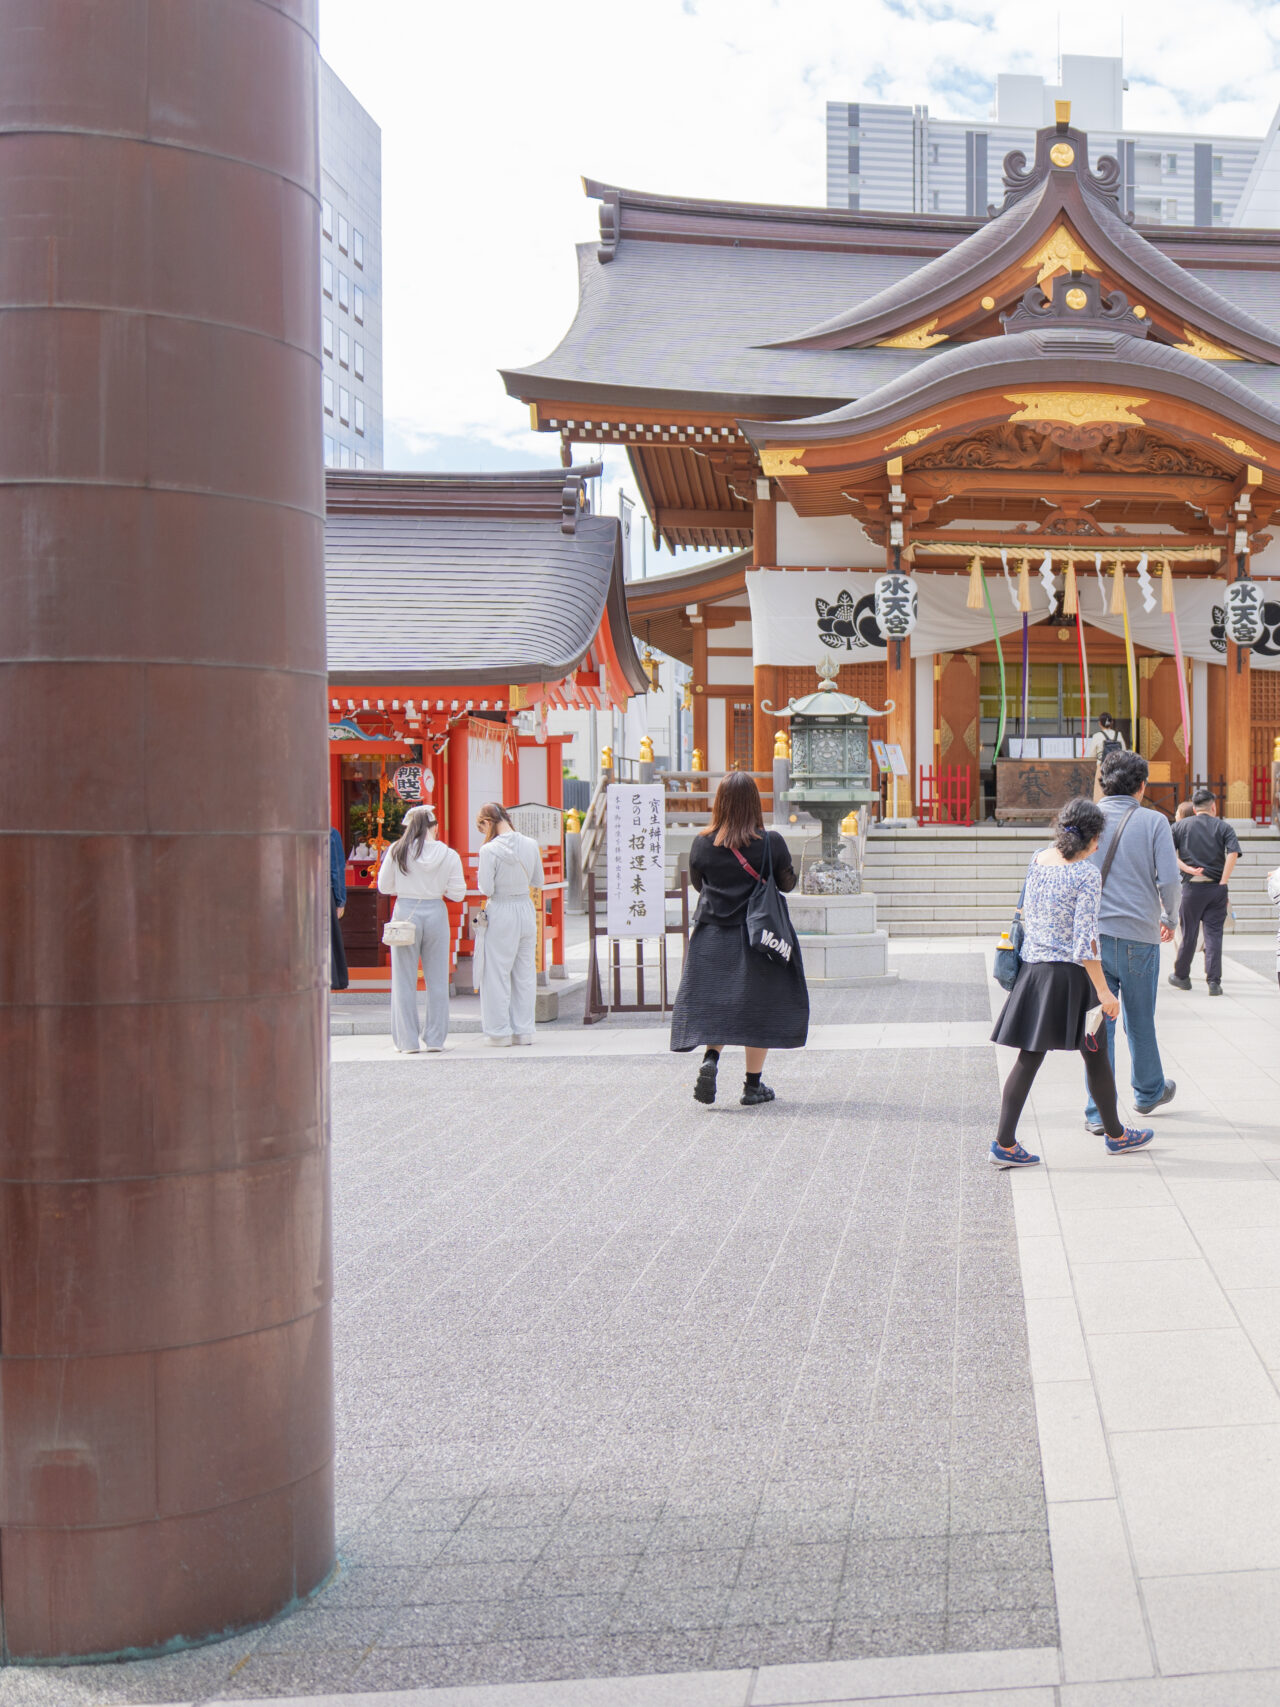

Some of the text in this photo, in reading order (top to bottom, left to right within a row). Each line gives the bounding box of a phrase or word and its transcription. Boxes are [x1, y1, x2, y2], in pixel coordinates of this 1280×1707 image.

[881, 577, 910, 634] 水天宮
[1230, 584, 1258, 642] 水天宮
[760, 929, 792, 961] MoMA
